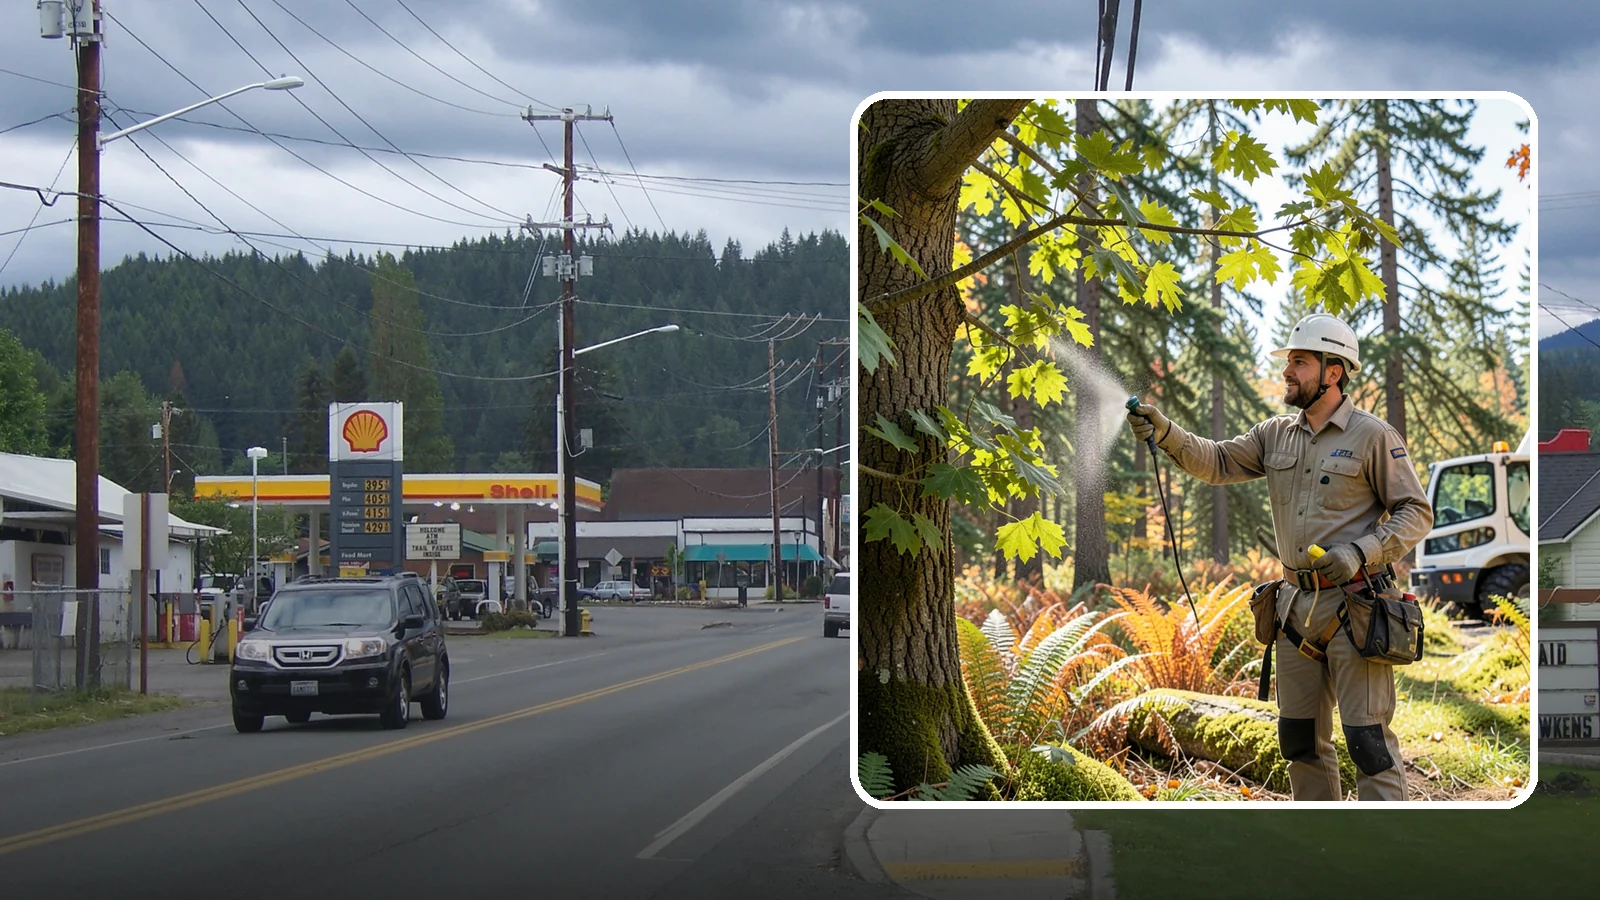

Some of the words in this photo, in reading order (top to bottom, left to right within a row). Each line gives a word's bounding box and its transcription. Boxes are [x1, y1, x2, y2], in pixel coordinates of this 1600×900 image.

[366, 480, 383, 490] 395
[490, 484, 547, 499] Shell
[366, 494, 383, 504] 405
[366, 508, 383, 518] 415
[366, 522, 383, 532] 429
